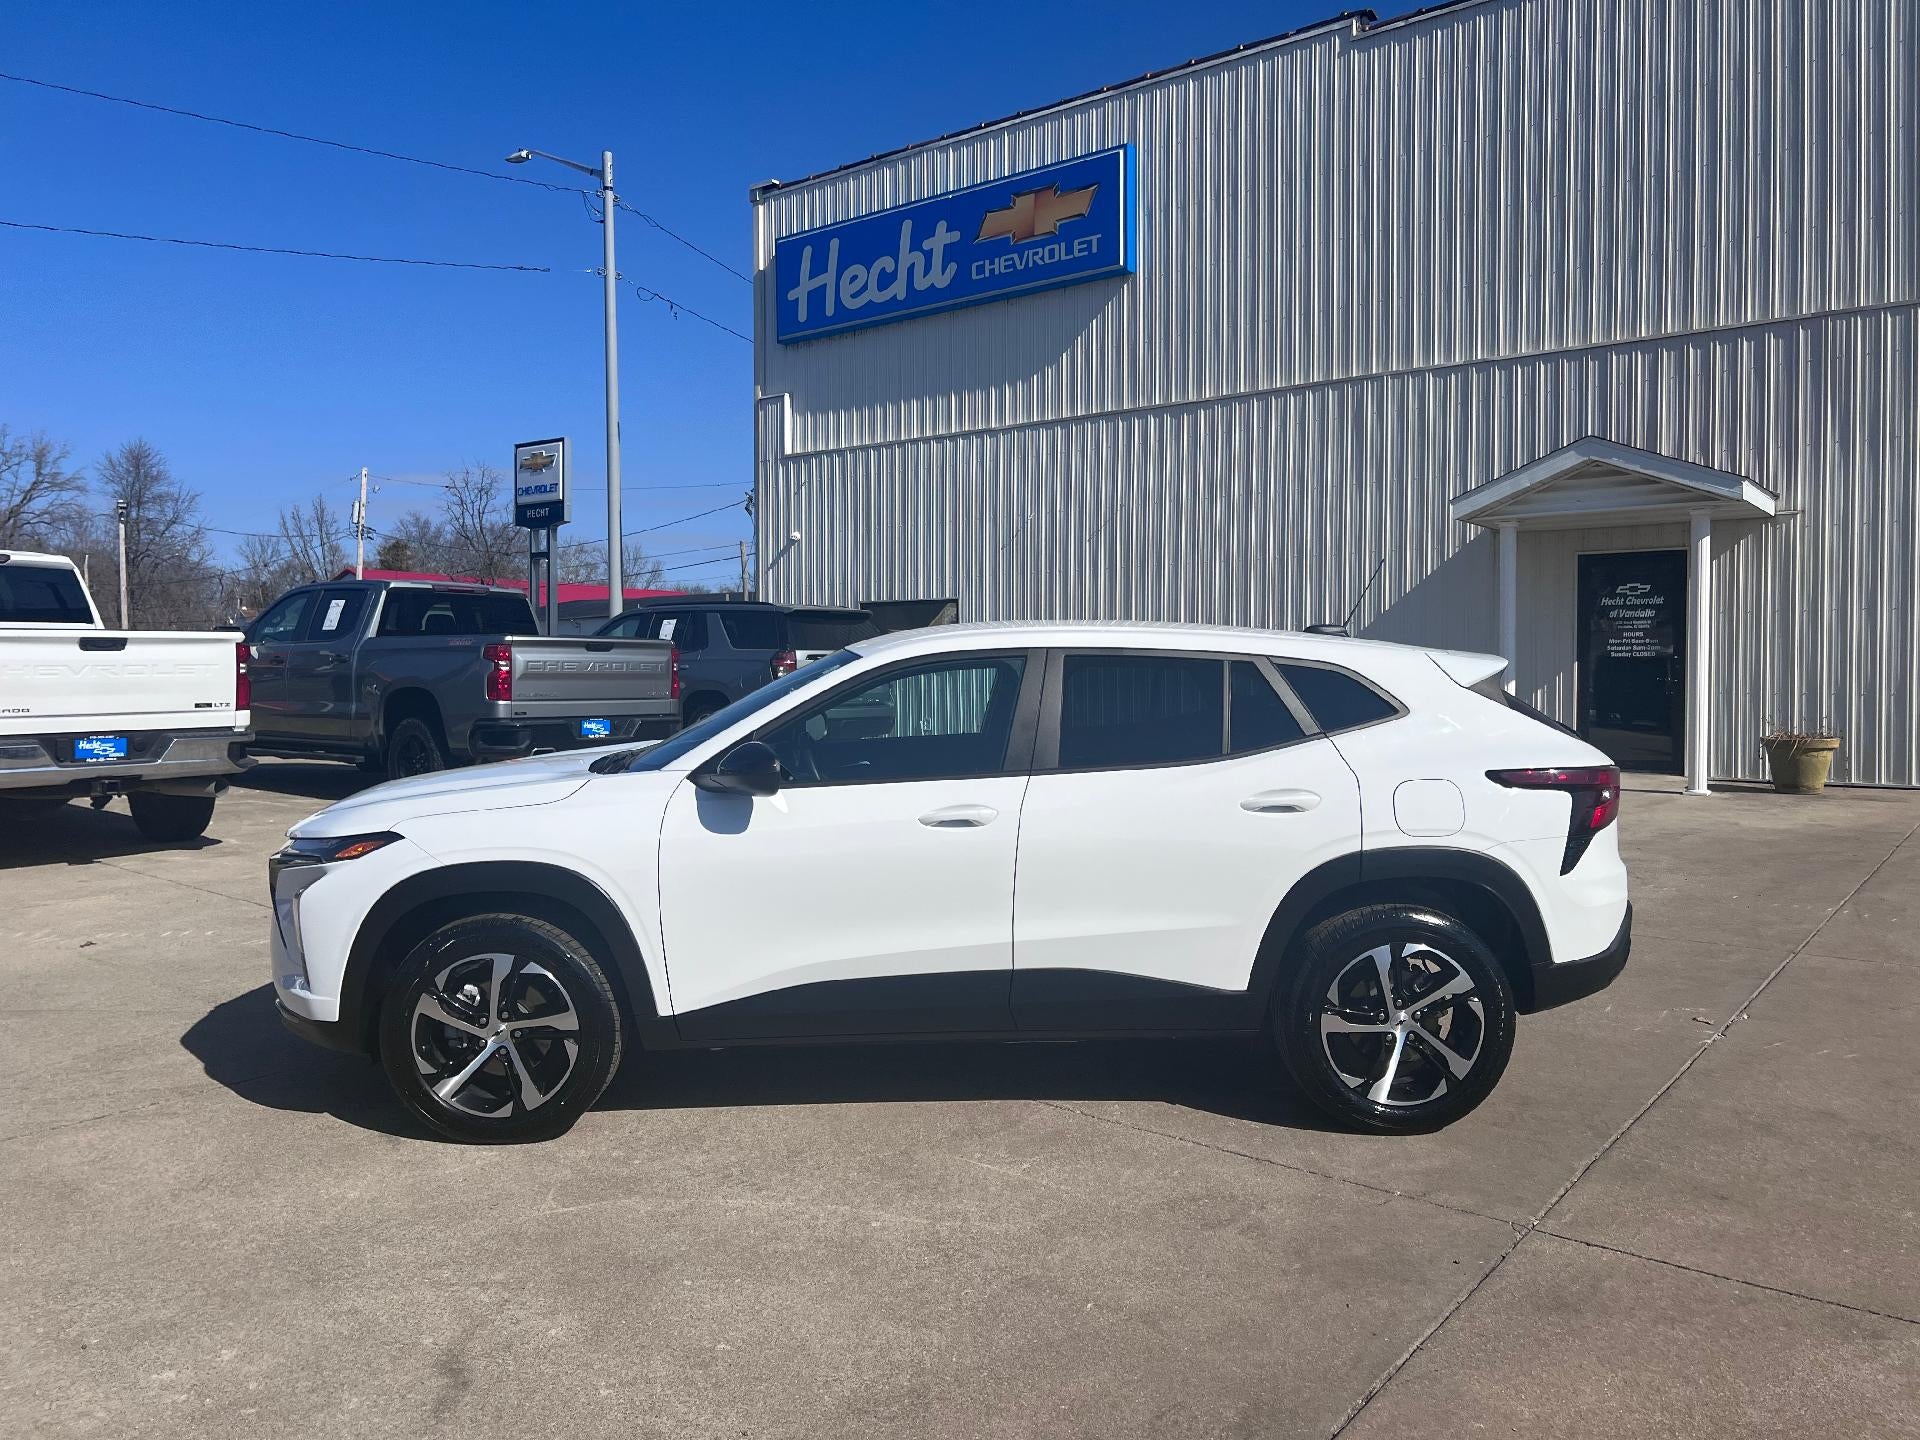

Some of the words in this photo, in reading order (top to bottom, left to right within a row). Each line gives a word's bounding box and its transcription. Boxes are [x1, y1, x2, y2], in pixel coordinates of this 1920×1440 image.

[971, 234, 1102, 281] CHEVROLET
[787, 219, 960, 322] Hecht
[517, 483, 558, 496] CHEVROLET
[527, 508, 549, 518] HECHT
[1601, 597, 1624, 606] Hecht
[1626, 596, 1664, 605] Chevrolet
[1609, 609, 1618, 618] of
[1619, 609, 1655, 617] Vandalia
[527, 660, 666, 672] CHEVROLET
